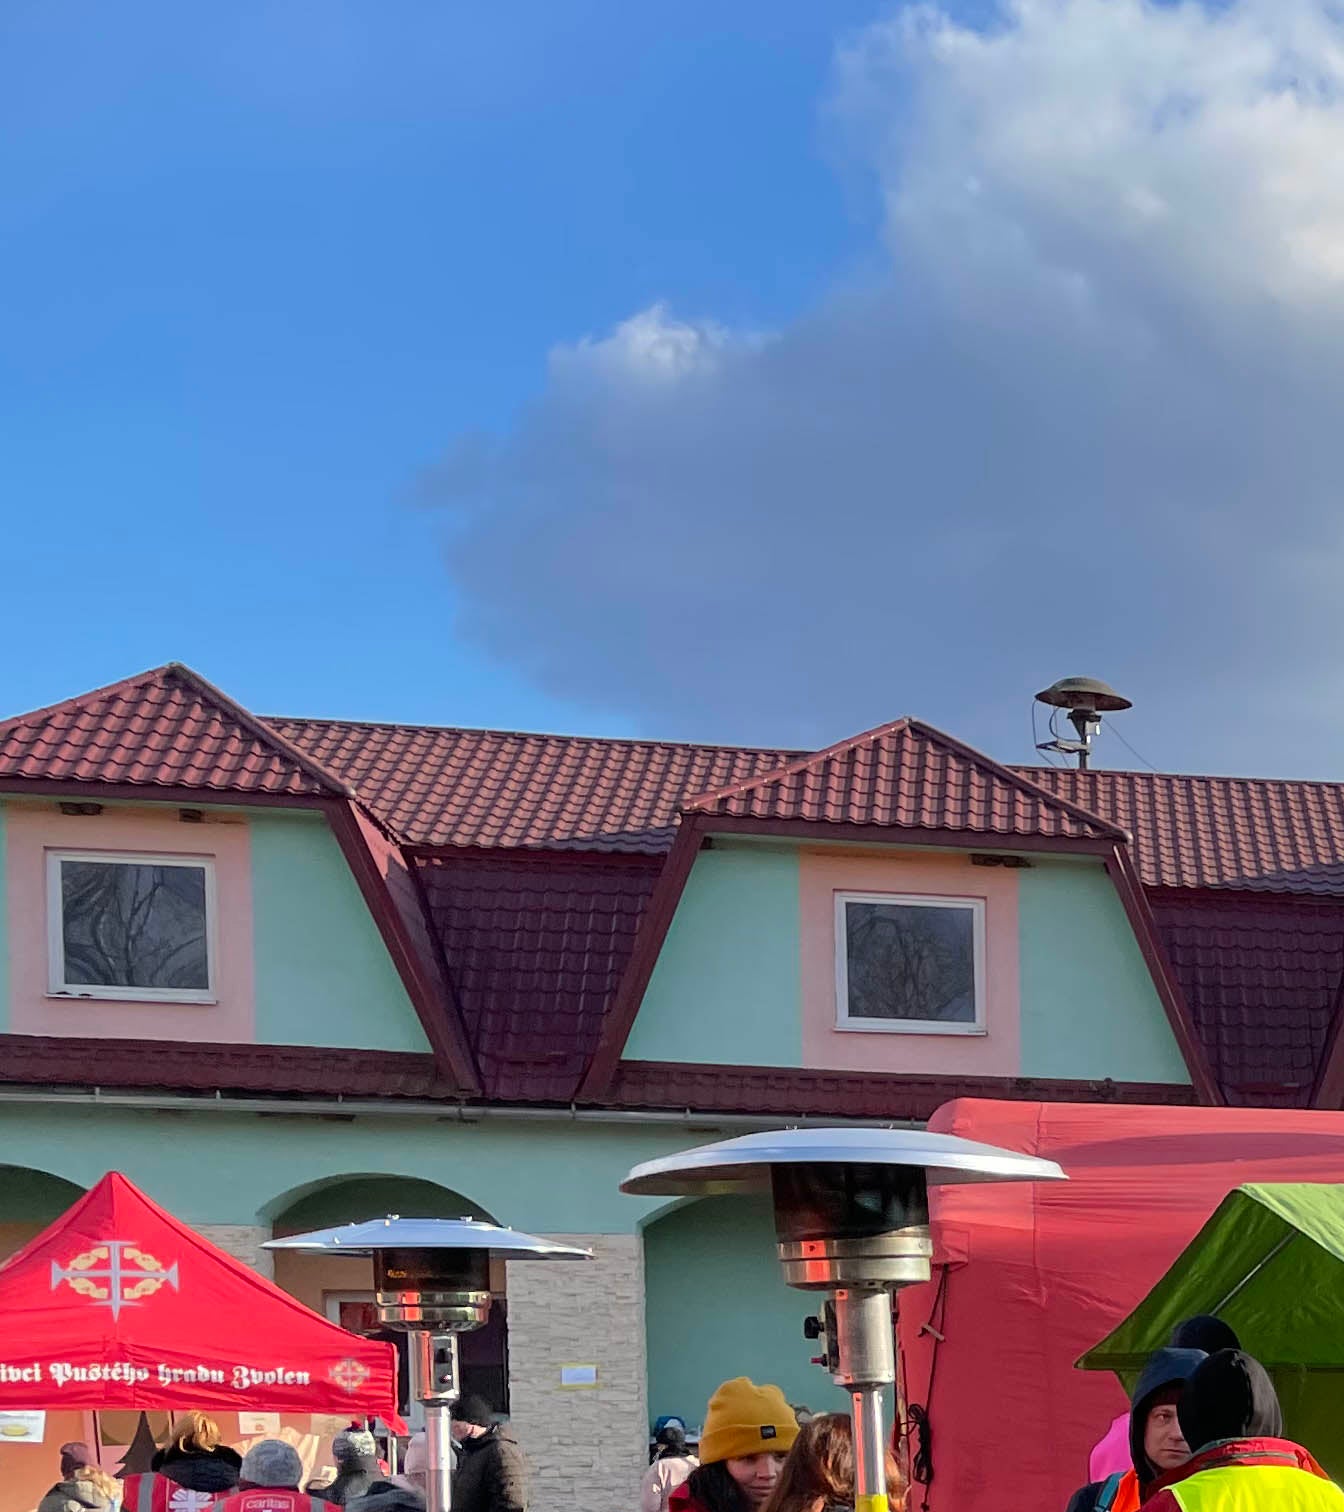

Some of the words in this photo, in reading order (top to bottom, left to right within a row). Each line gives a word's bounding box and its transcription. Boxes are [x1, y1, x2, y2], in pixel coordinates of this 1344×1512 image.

[0, 1362, 42, 1383] ivci
[50, 1362, 149, 1387] Pustého
[158, 1363, 225, 1386] hradu
[231, 1365, 310, 1389] Zvolen
[246, 1498, 290, 1509] caritas
